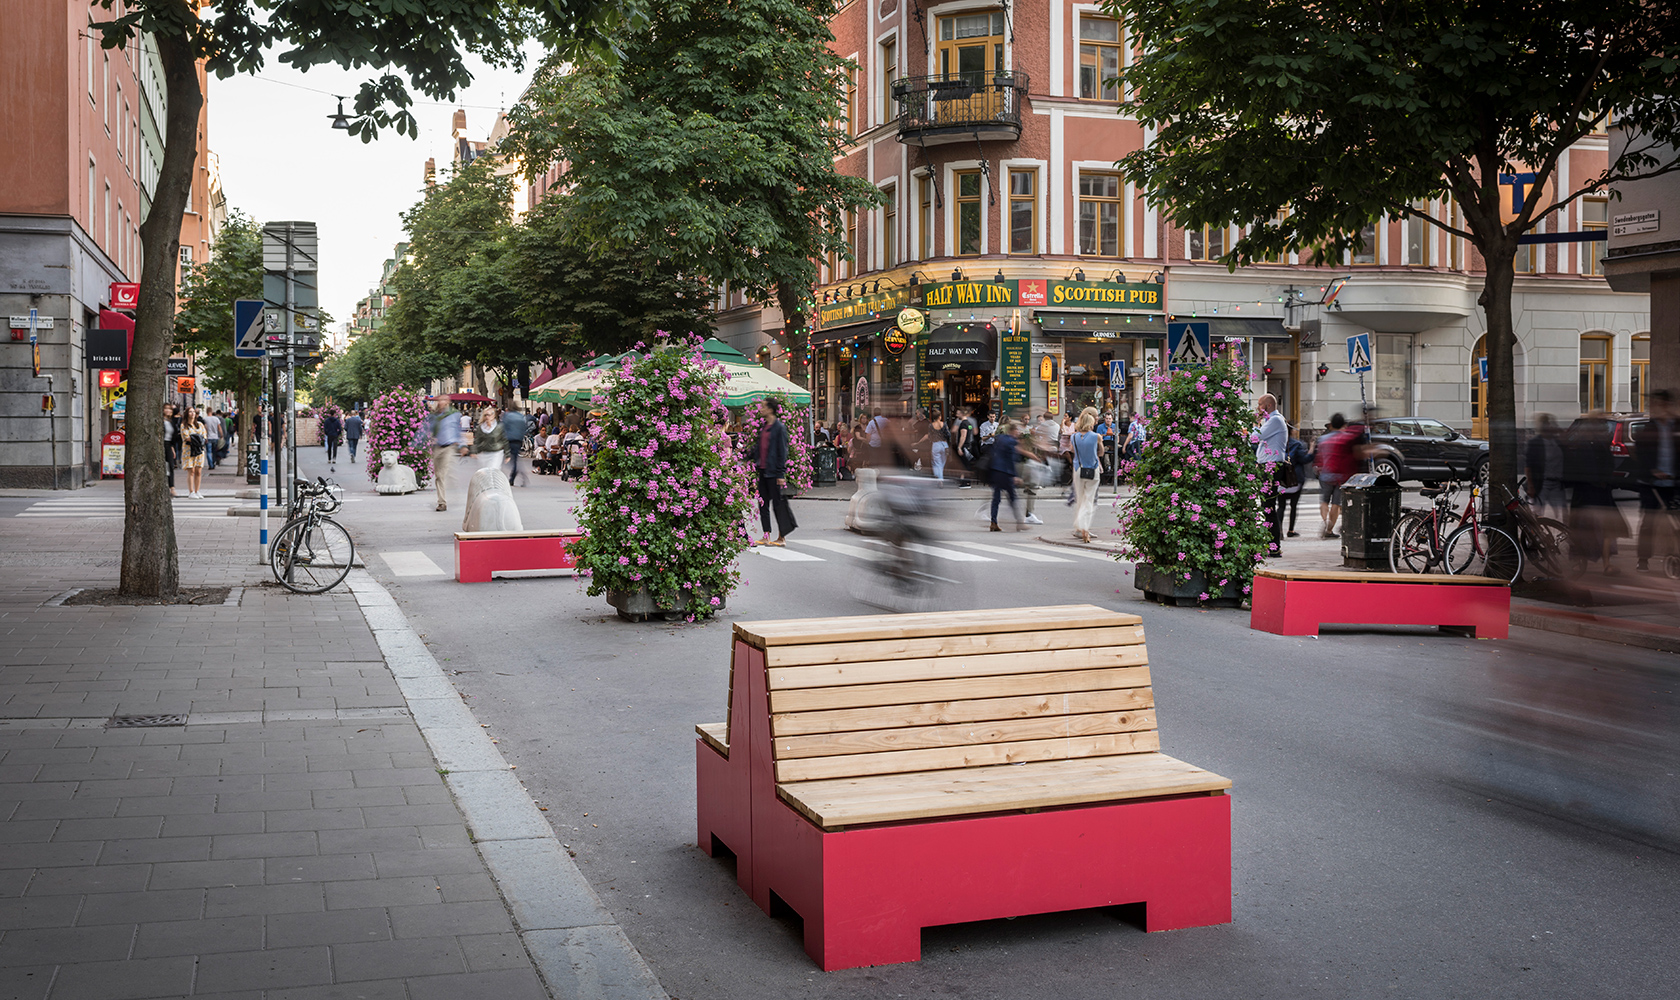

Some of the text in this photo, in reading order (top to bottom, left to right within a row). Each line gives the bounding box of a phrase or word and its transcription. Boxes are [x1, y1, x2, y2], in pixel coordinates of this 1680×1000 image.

[1499, 172, 1542, 214] T
[1614, 213, 1655, 224] Swedenborgsgatan
[926, 284, 954, 307] HALF
[956, 282, 983, 304] WAY
[986, 284, 1012, 303] INN
[1053, 285, 1158, 304] SCOTTISH PUB
[821, 308, 843, 325] SCOTTISH
[843, 303, 854, 319] PUB
[854, 301, 867, 316] WITH
[867, 297, 896, 314] TRADITION
